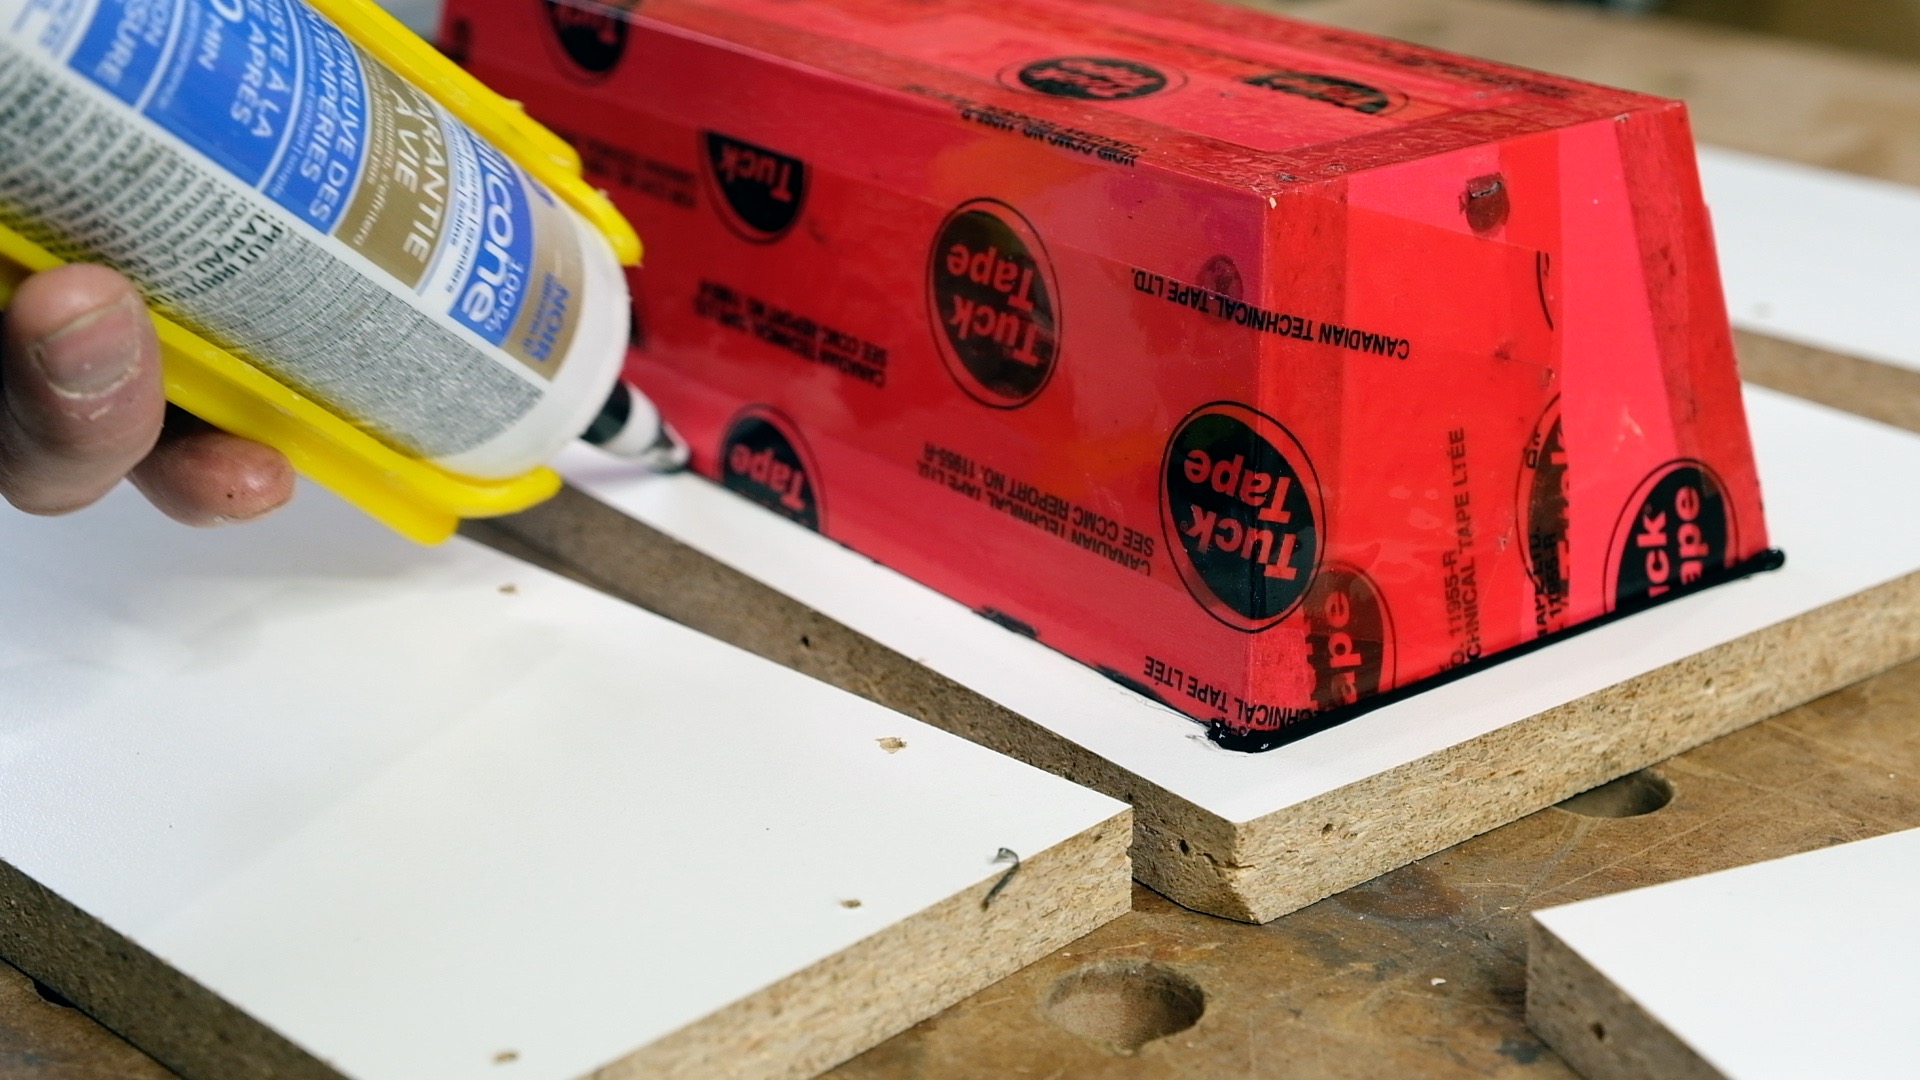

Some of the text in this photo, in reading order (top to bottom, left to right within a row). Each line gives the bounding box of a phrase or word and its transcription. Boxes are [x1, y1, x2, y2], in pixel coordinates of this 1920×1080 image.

[95, 0, 147, 86] SURE
[198, 10, 224, 72] MIN
[262, 0, 290, 68] ISTE
[308, 160, 350, 223] DES
[394, 127, 421, 194] VIE
[403, 84, 448, 264] ARANTIE
[719, 142, 794, 203] Tuck
[239, 213, 268, 235] LA
[239, 224, 284, 265] PEUT
[461, 136, 515, 323] ilicone
[483, 257, 525, 333] 100%
[946, 242, 1035, 312] Tape
[949, 294, 1041, 367] Tuck
[1130, 267, 1411, 360] CANADIAN TECHNICAL TAPE LTD.
[729, 442, 807, 512] Tape
[1007, 478, 1071, 520] REPORT
[1183, 448, 1292, 524] Tape
[1072, 506, 1120, 543] CCMC
[1122, 526, 1156, 559] SEE
[1185, 503, 1299, 581] Tuck
[1454, 490, 1475, 555] TAPE
[1674, 484, 1710, 586] ape
[1442, 548, 1465, 638] 11955-R
[1459, 557, 1483, 663] CHNICAL
[1142, 654, 1184, 693] LTÉE
[1323, 591, 1363, 706] ape
[1186, 675, 1230, 714] TAPE
